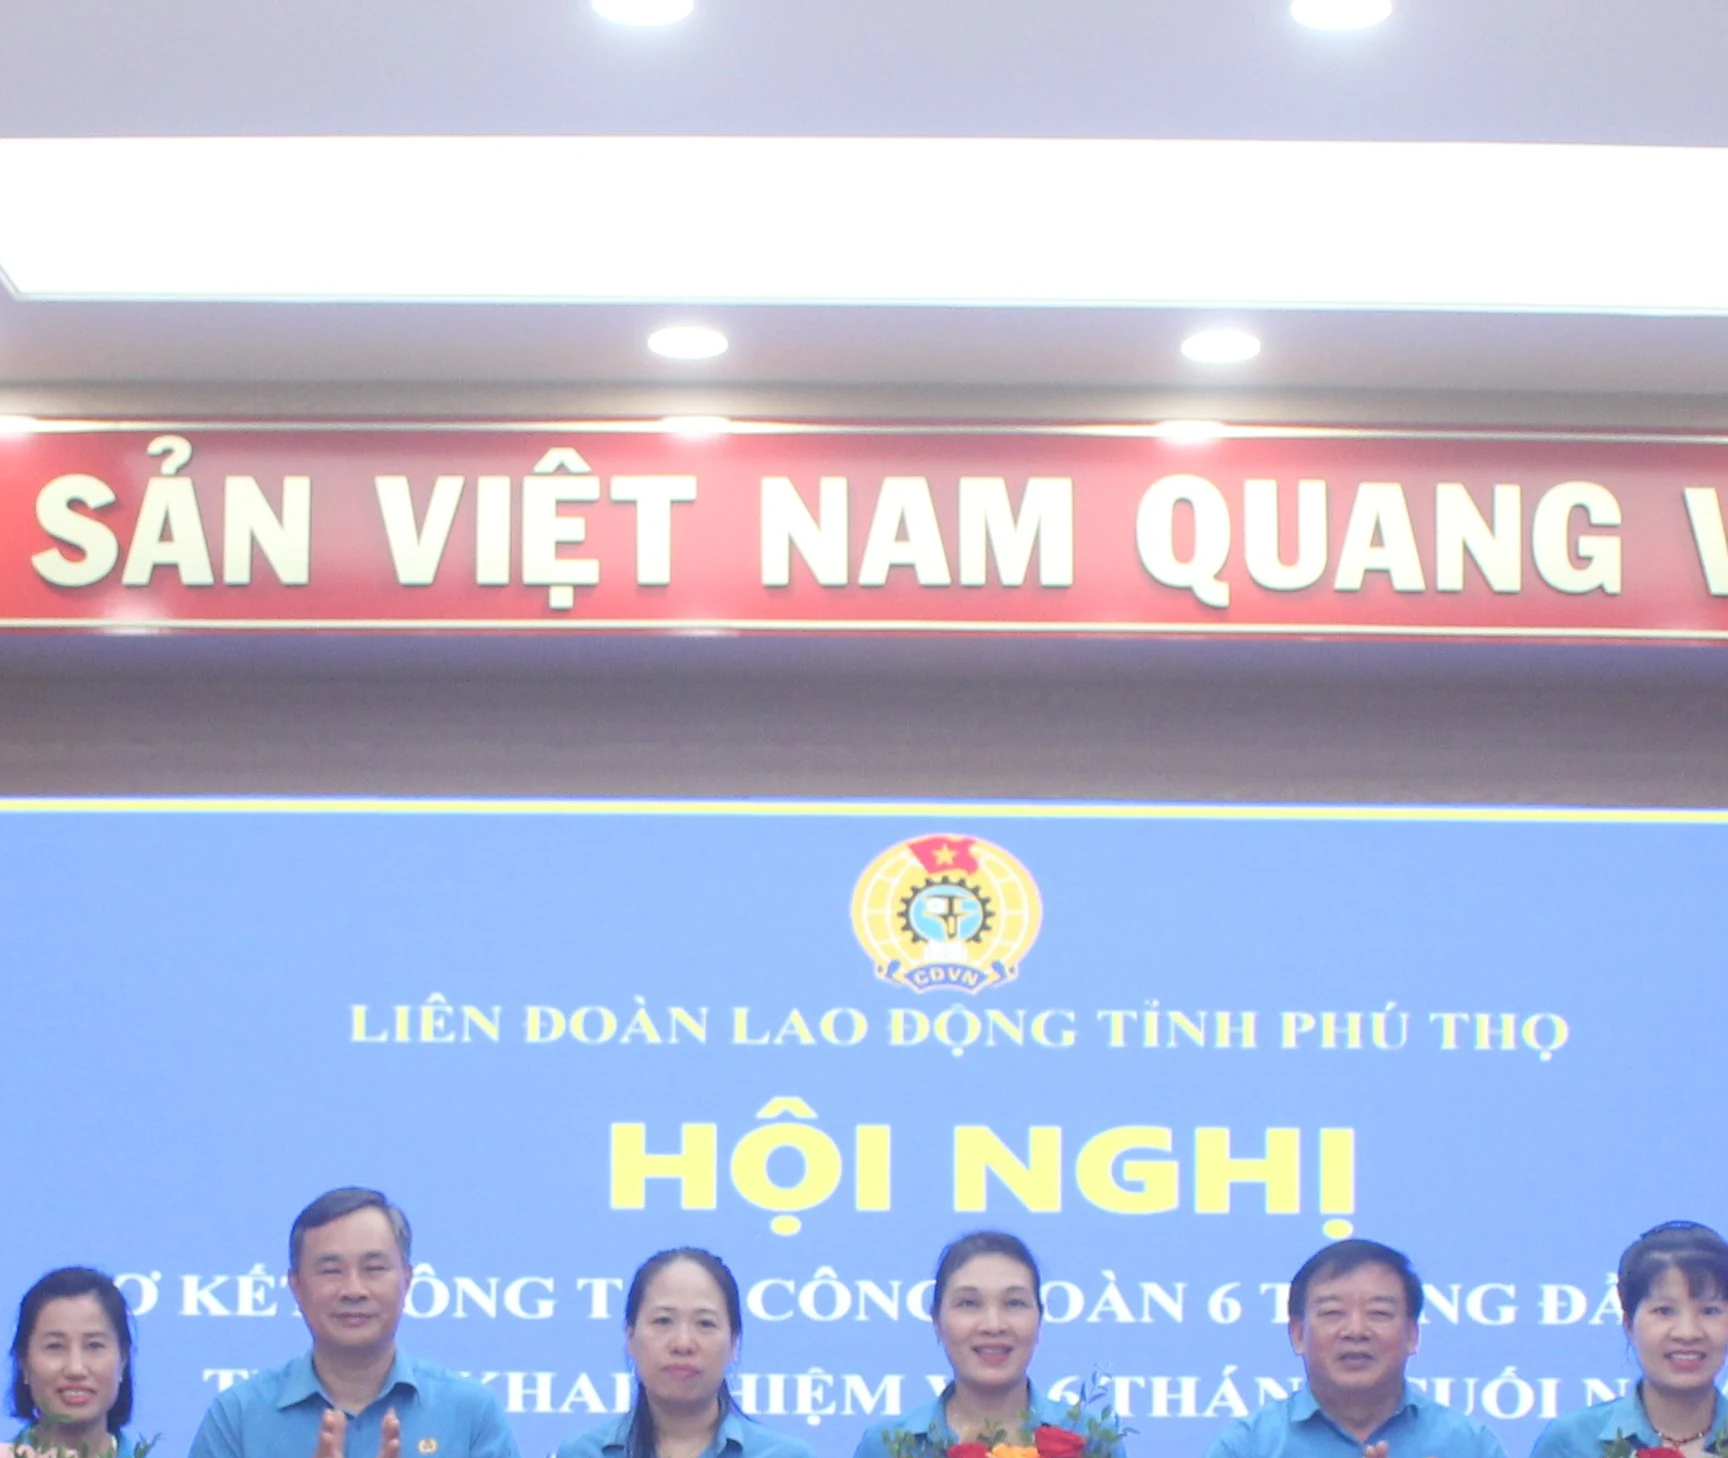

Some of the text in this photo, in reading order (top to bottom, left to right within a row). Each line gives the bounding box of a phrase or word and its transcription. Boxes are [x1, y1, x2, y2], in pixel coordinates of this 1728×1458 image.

[30, 436, 311, 587] SẢN
[374, 447, 697, 608] VIỆT
[760, 475, 1073, 588] NAM
[1136, 474, 1622, 607] QUANG
[350, 992, 1568, 1061] LIÊN ĐOÀN LAO ĐỘNG TỈNH PHÚ THỌ
[610, 1096, 1356, 1240] HỘI NGHỊ
[402, 1263, 557, 1319] ÔNG
[1041, 1270, 1188, 1324] OÀN
[1208, 1281, 1242, 1324] 6
[728, 1366, 904, 1426] HIỆM
